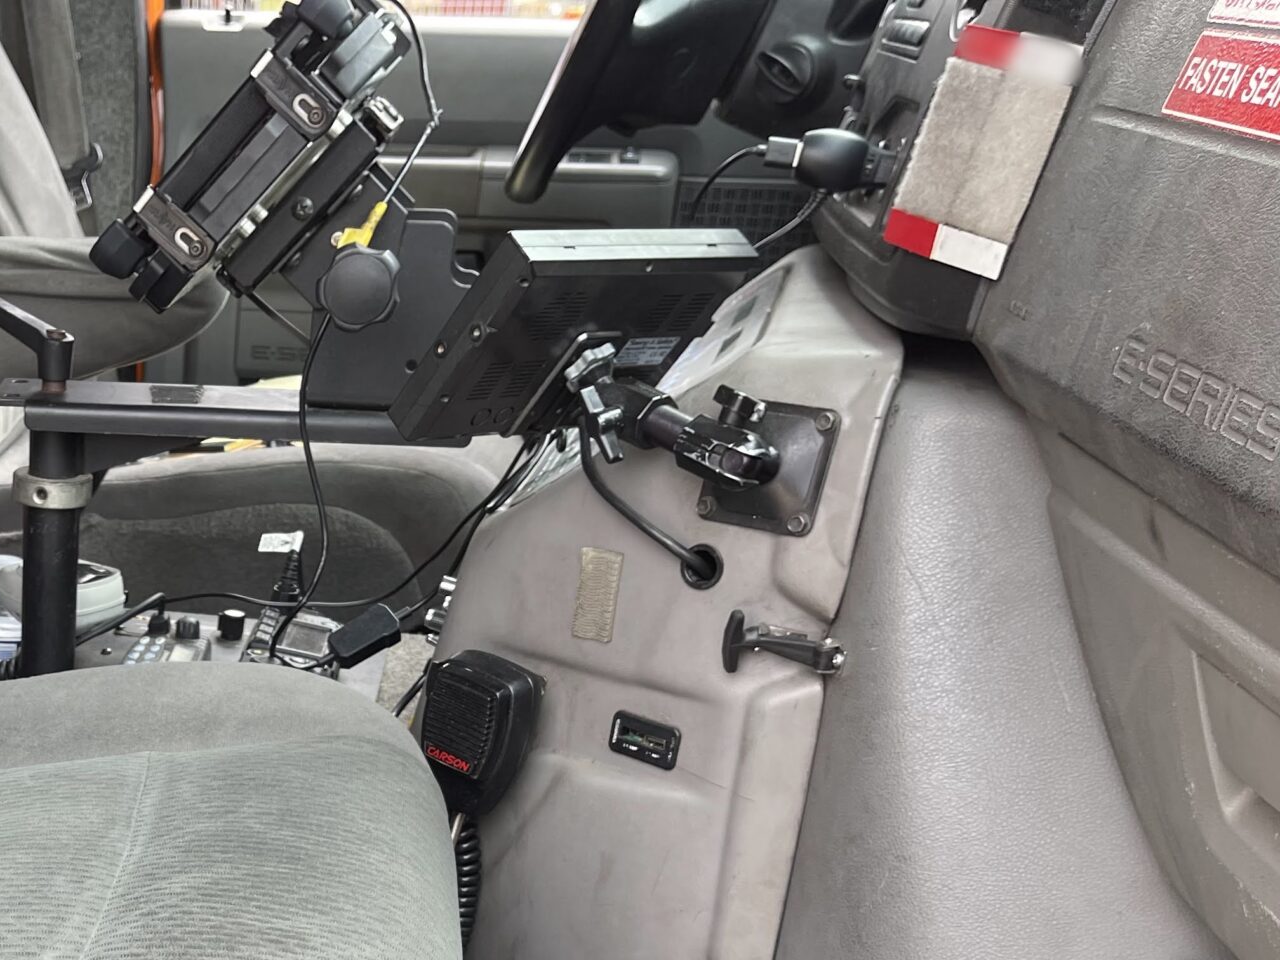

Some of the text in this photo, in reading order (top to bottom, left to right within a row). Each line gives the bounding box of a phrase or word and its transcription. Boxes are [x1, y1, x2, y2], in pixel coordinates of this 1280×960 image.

[1178, 56, 1280, 108] FASTEN SEA
[427, 746, 470, 771] CARSON
